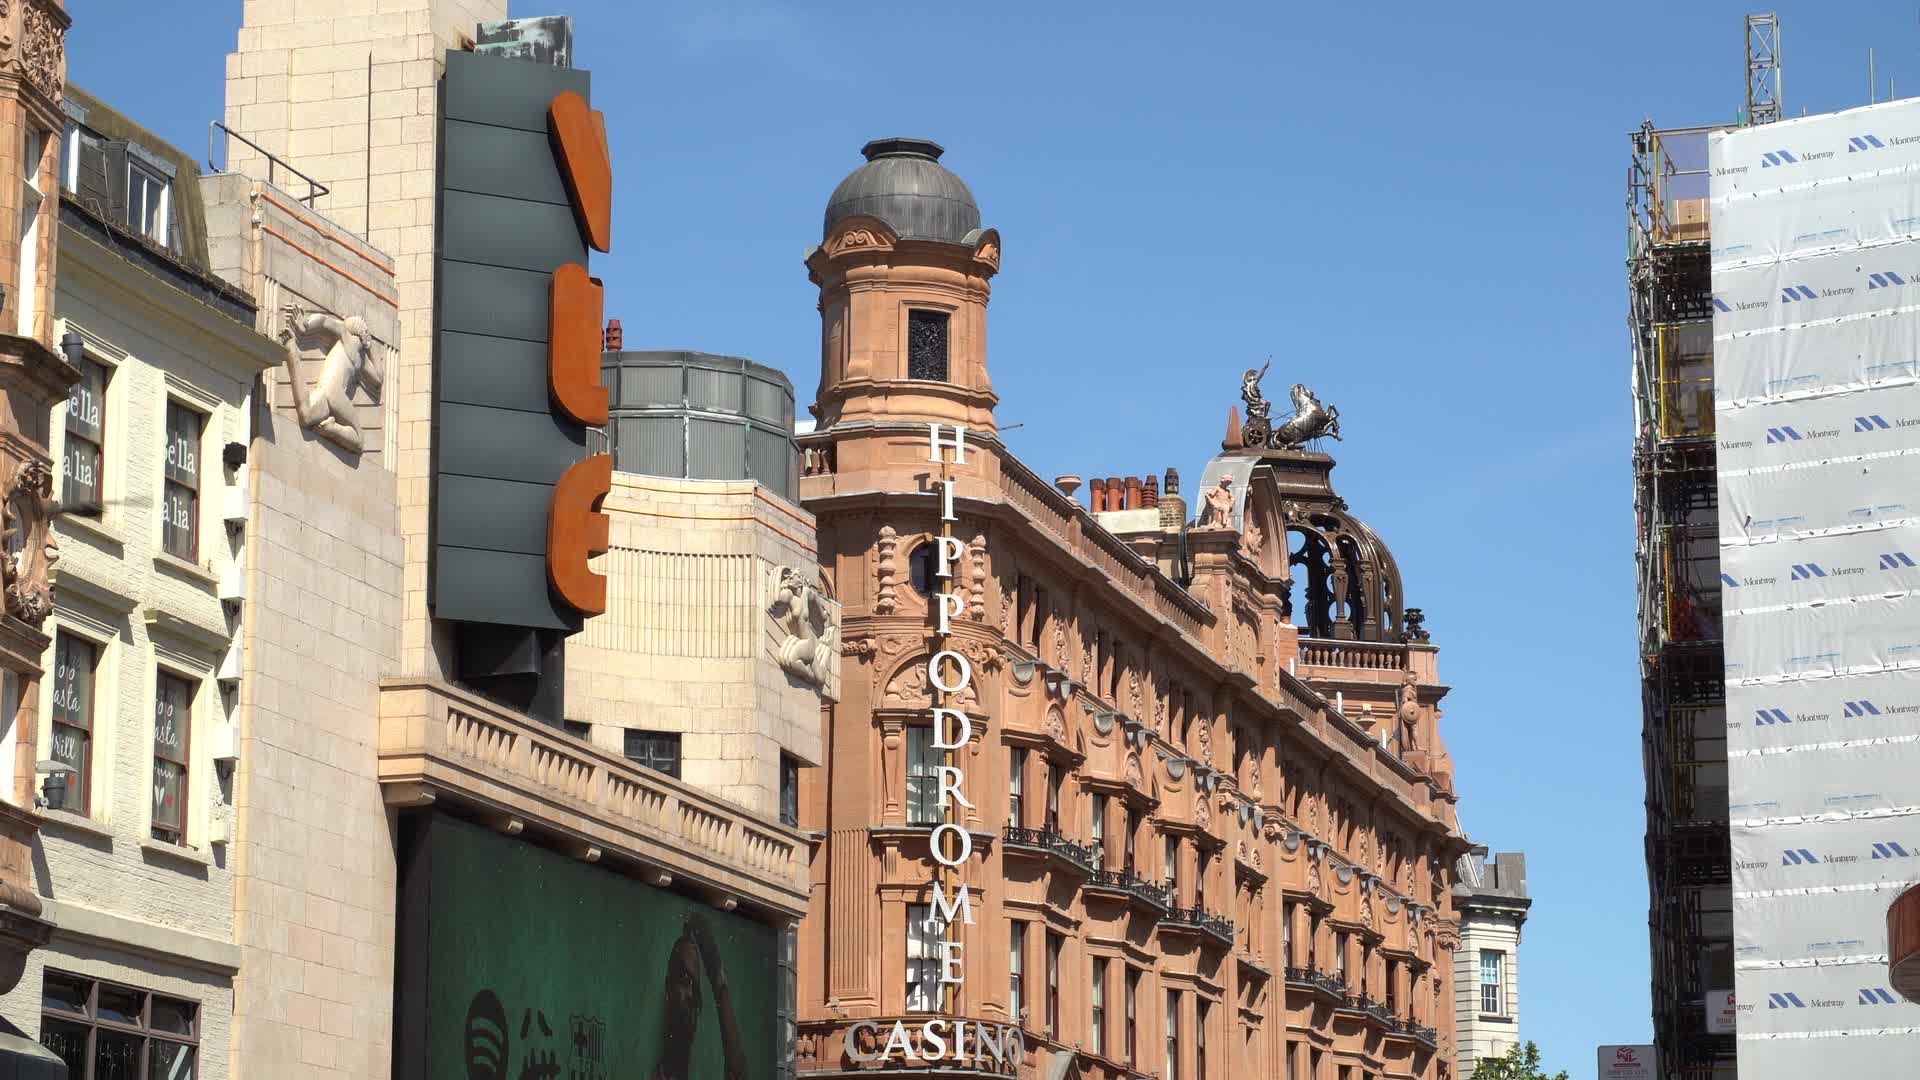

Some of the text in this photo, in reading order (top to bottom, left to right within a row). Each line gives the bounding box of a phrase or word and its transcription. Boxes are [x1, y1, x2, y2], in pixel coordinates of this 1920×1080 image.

[1801, 150, 1835, 162] Montway
[1716, 165, 1750, 177] Montway
[1821, 287, 1855, 299] Montway
[1736, 301, 1769, 313] Montway
[1806, 428, 1840, 441] Montway
[1720, 440, 1753, 453] Montway
[1832, 566, 1865, 578] Montway
[1744, 576, 1777, 588] Montway
[926, 422, 976, 984] HIPPODROME
[1796, 712, 1830, 724] Montway
[1735, 859, 1769, 873] Montway
[1823, 854, 1858, 866] Montway
[1810, 997, 1845, 1010] Montway
[844, 1019, 1025, 1068] CASINO
